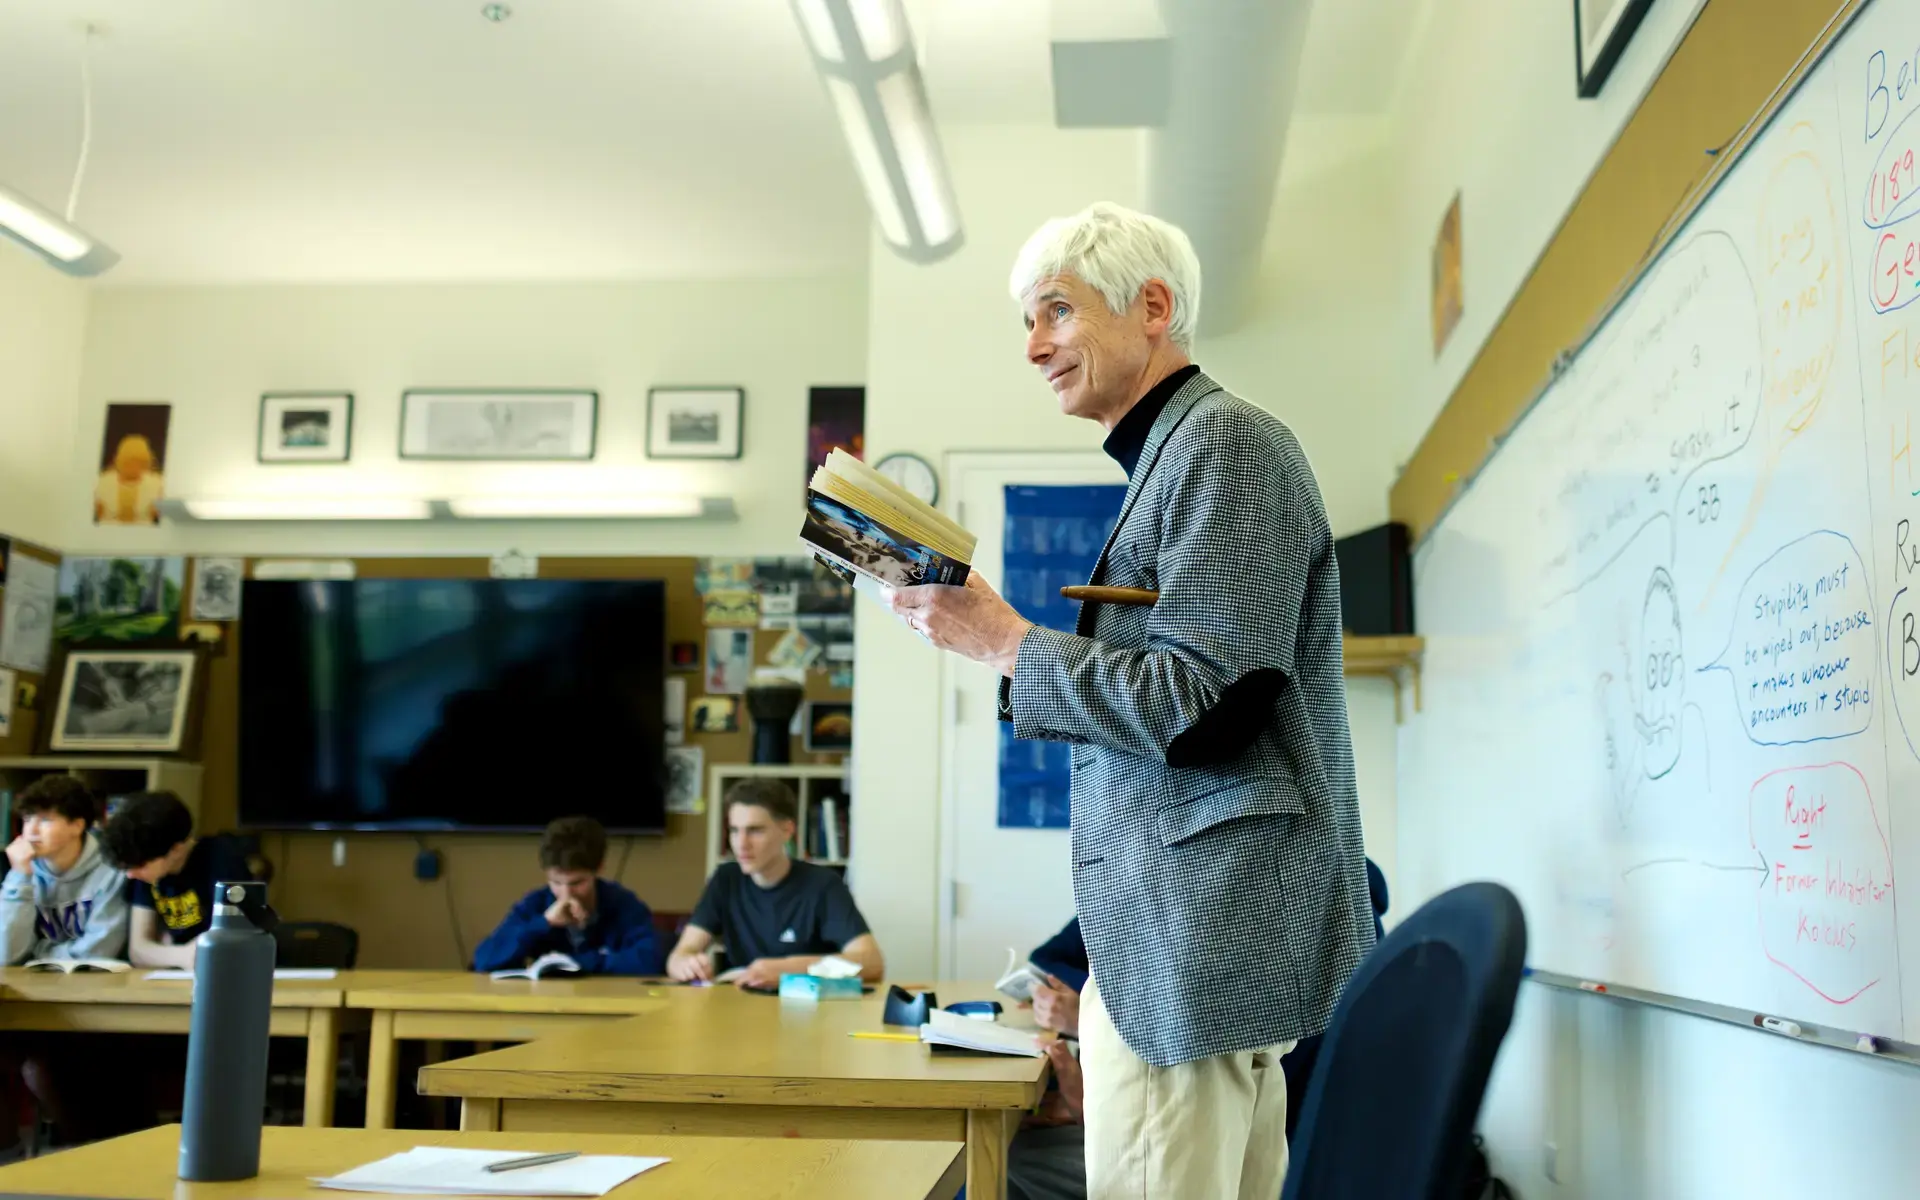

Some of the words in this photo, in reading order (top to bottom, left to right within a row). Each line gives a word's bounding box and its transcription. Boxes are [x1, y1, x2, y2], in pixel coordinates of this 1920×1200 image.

[1874, 233, 1920, 306] Ge
[1755, 581, 1809, 626] Stupidity
[1815, 562, 1849, 597] must
[1745, 641, 1758, 666] be
[1763, 627, 1793, 667] wiped
[1824, 610, 1871, 642] because
[1802, 657, 1850, 685] whoever
[1751, 698, 1807, 728] encounters
[1815, 691, 1828, 712] it
[1785, 784, 1827, 838] Right
[1775, 861, 1819, 897] Former
